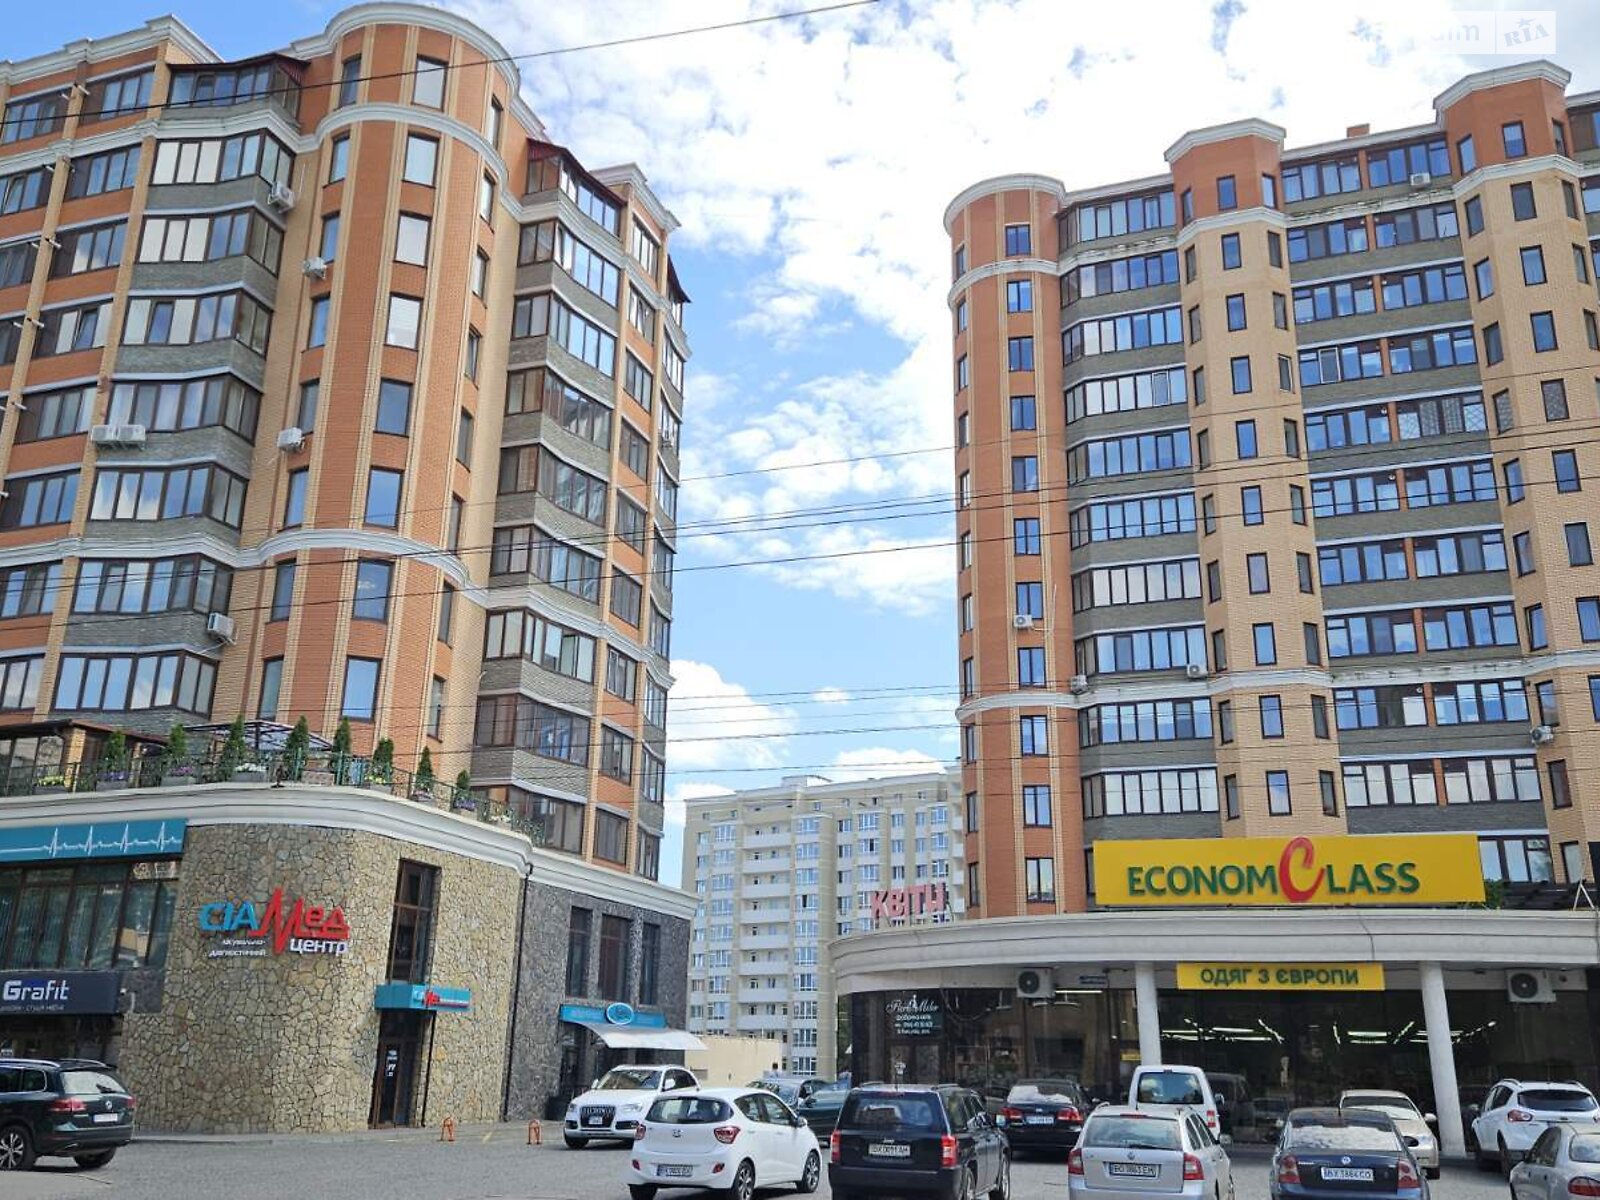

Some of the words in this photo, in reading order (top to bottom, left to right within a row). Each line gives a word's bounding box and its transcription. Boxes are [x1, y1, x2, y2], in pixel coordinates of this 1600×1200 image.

[290, 938, 349, 956] центр
[1200, 968, 1252, 986] ОДЯГ
[1275, 968, 1359, 985] ЄВРОПИ
[3, 979, 70, 1001] Grafit
